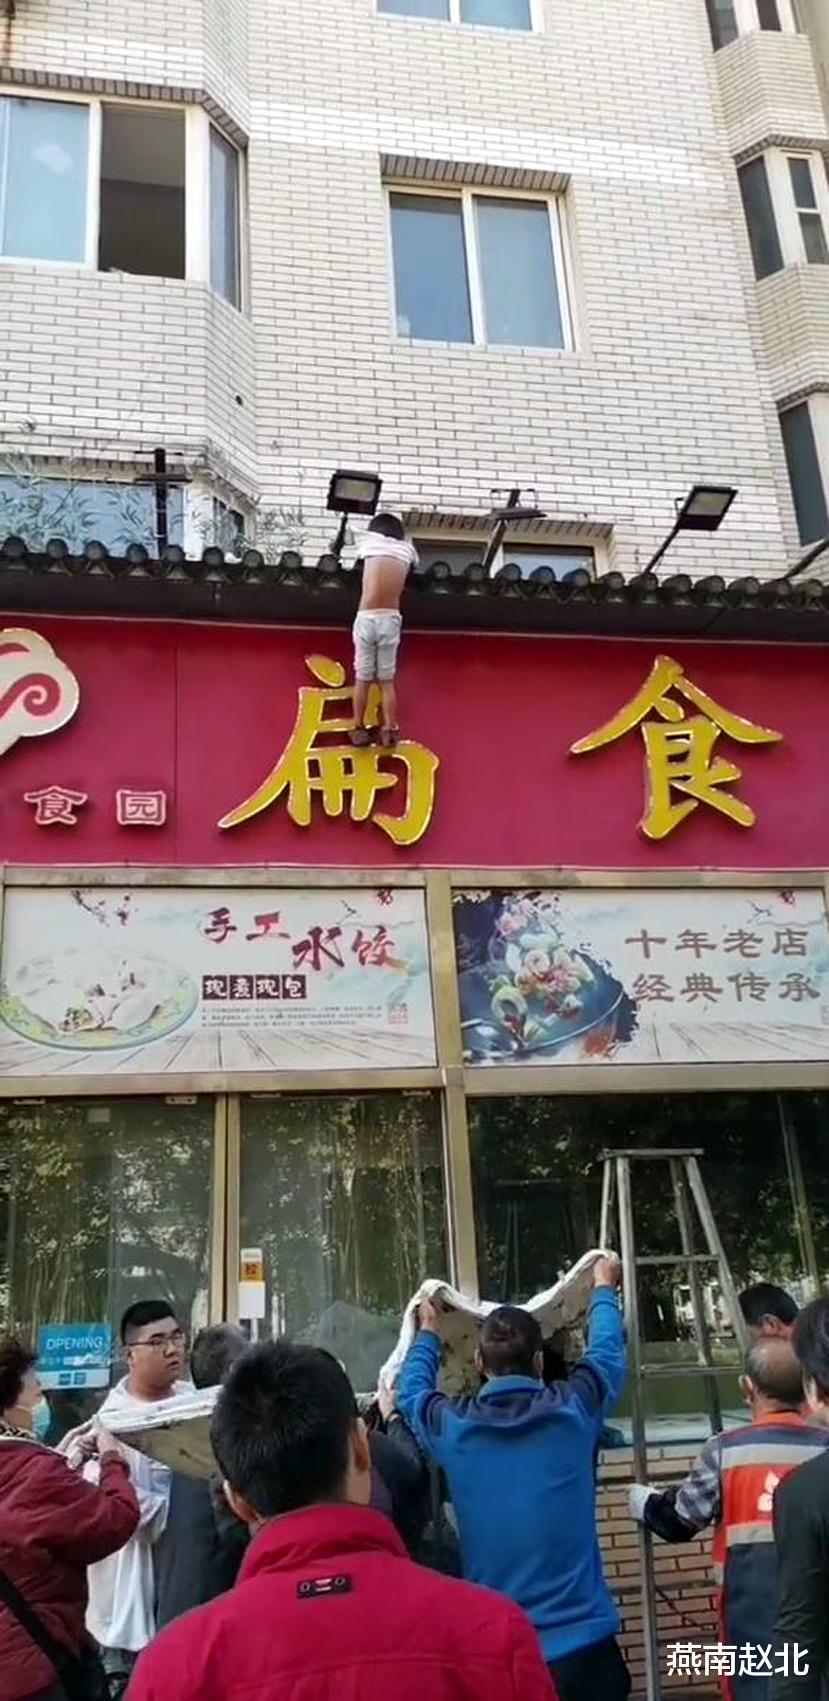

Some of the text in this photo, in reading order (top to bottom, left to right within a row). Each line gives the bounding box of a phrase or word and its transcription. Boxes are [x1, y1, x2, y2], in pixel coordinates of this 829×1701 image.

[218, 653, 784, 846] 扁食
[24, 785, 166, 825] 食园
[204, 907, 408, 974] 手工水饺
[625, 928, 809, 959] 十年老店
[202, 975, 308, 1000] 现煮现包
[632, 972, 821, 1002] 经典传承
[46, 1335, 104, 1350] OPENING
